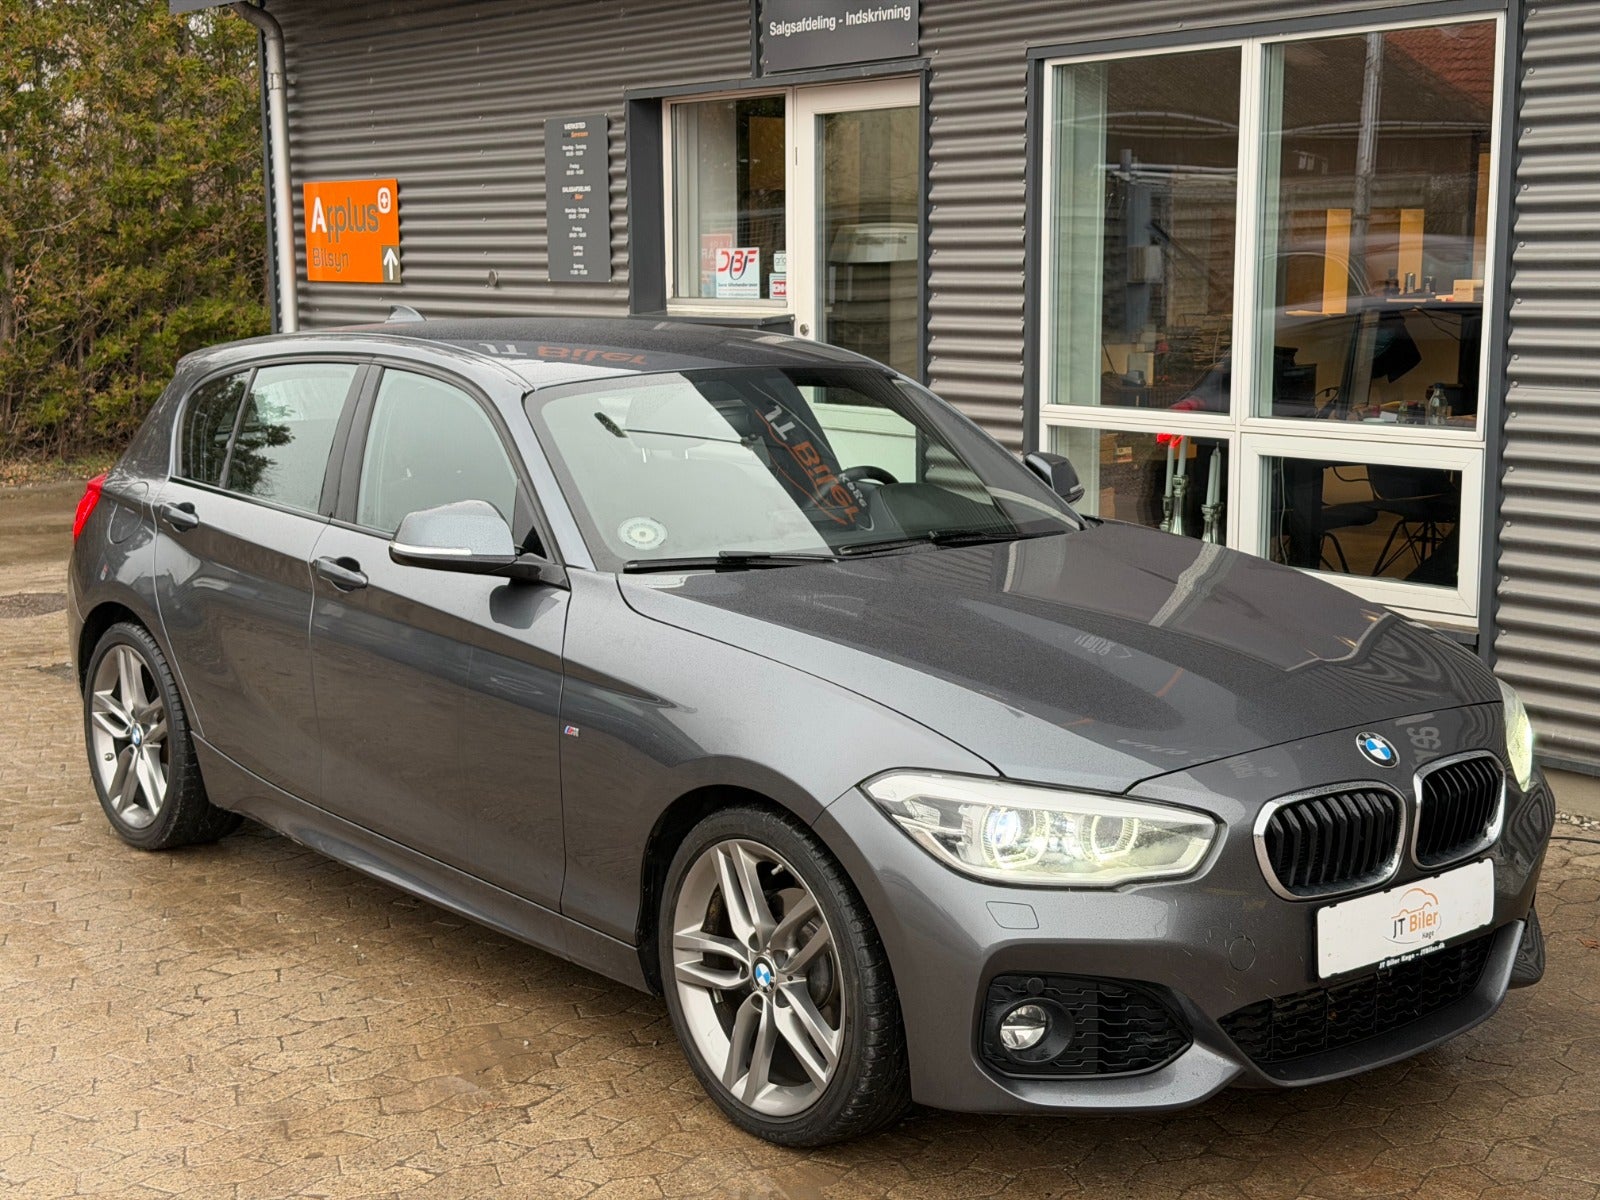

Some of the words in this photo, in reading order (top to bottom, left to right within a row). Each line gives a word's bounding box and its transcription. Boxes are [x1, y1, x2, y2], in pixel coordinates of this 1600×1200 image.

[769, 16, 836, 37] Salgsafdeling
[846, 5, 911, 26] Indskrivning
[312, 247, 349, 272] Bilsyn
[1393, 917, 1406, 939] JT
[1409, 910, 1438, 932] Biler
[1379, 961, 1386, 970] JT
